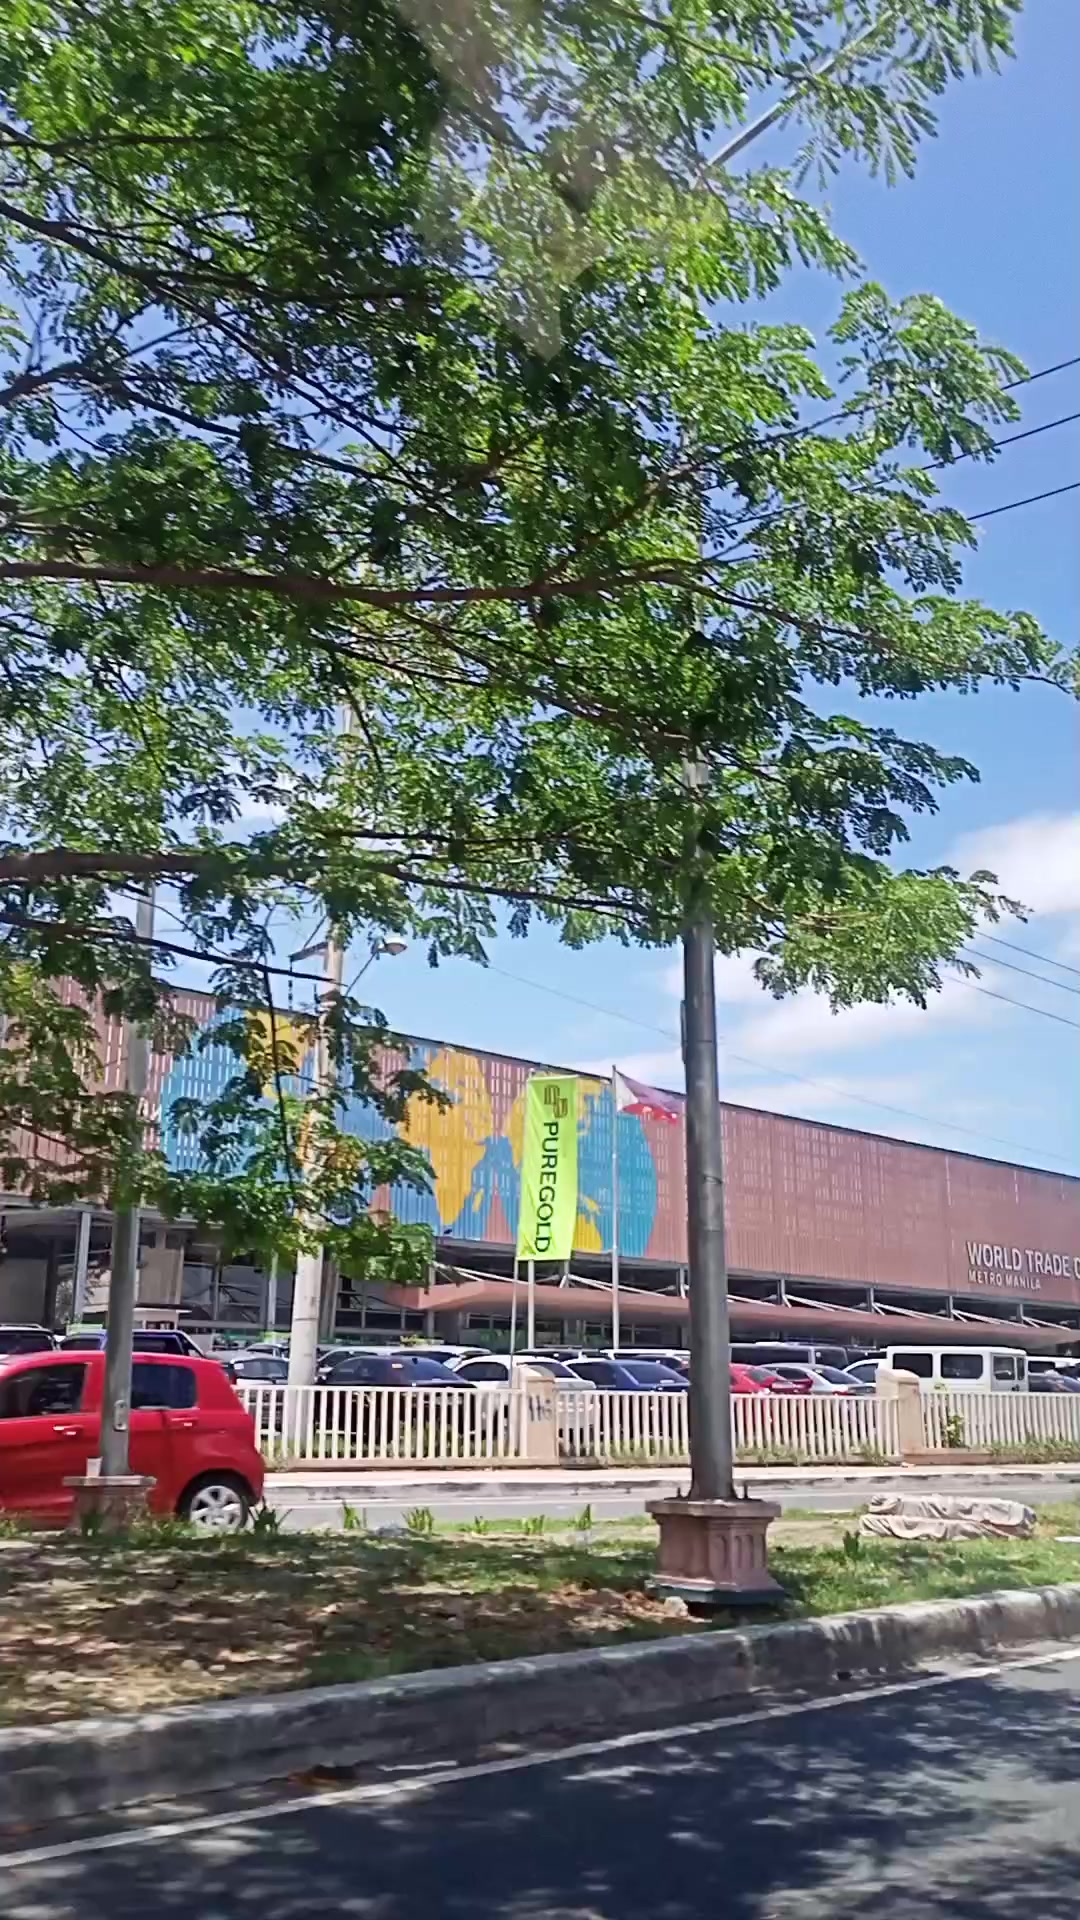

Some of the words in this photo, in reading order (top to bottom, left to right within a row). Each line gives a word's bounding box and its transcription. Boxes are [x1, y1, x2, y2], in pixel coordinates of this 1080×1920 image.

[534, 1121, 559, 1253] PUREGOLD
[967, 1241, 1022, 1270] WORLD
[1025, 1249, 1071, 1277] TRADE
[968, 1269, 1002, 1287] METRO
[1005, 1274, 1041, 1290] MANILA
